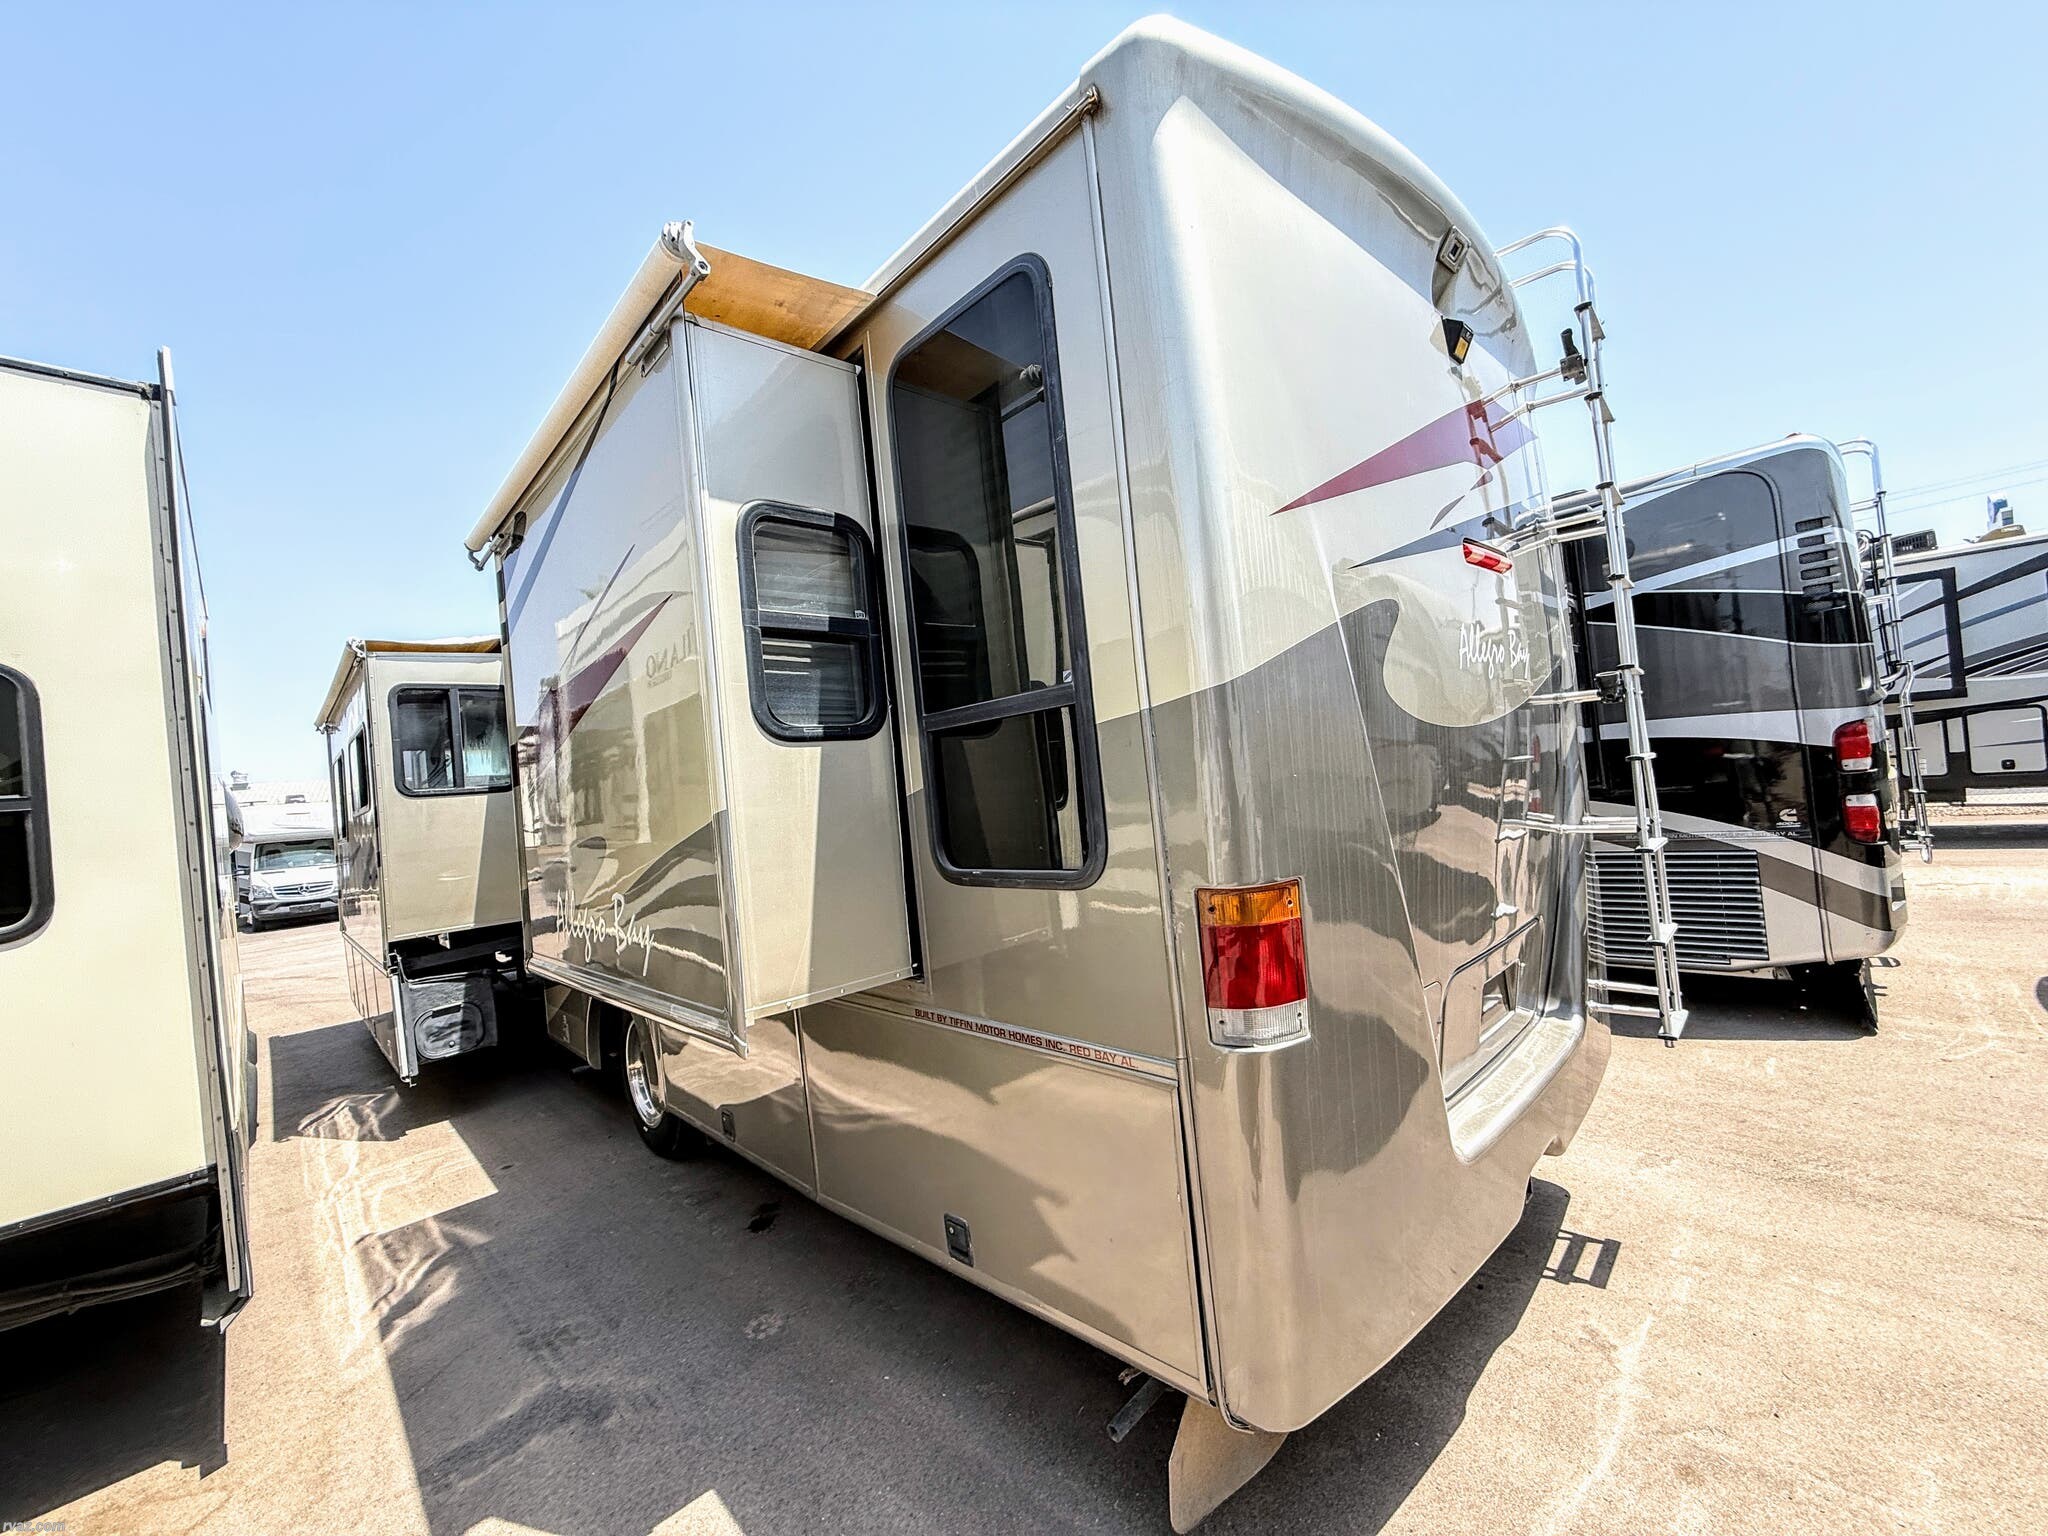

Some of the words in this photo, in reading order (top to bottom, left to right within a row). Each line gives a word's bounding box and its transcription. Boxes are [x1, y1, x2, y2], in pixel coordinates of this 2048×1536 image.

[1459, 622, 1505, 680] Allegro
[1508, 629, 1530, 680] Bay
[556, 889, 607, 963] Allegro
[611, 891, 656, 977] Bay
[915, 1008, 935, 1020] BUILT
[937, 1013, 948, 1023] BY
[949, 1016, 973, 1030] TIFFIN
[975, 1021, 1006, 1037] MOTOR
[1008, 1030, 1043, 1047] HOMES
[1045, 1038, 1066, 1051] INC.
[1069, 1044, 1091, 1058] RED
[1094, 1050, 1117, 1064] BAY
